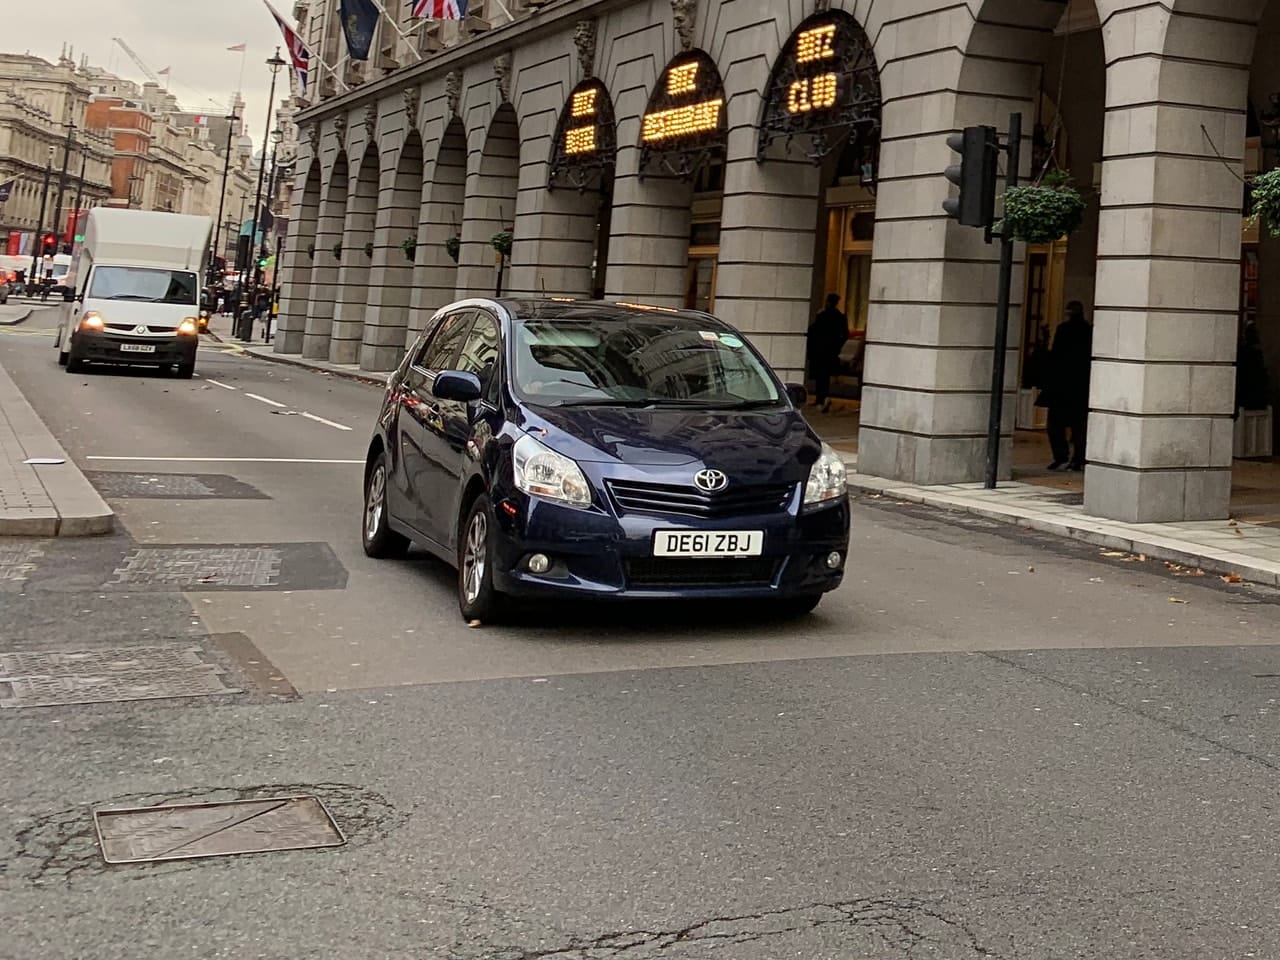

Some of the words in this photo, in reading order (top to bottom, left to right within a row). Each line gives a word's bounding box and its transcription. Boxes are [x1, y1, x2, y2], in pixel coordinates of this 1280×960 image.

[797, 25, 835, 62] RITZ
[789, 73, 836, 112] CLUB
[666, 535, 709, 552] DE61
[714, 534, 752, 552] ZBJ
